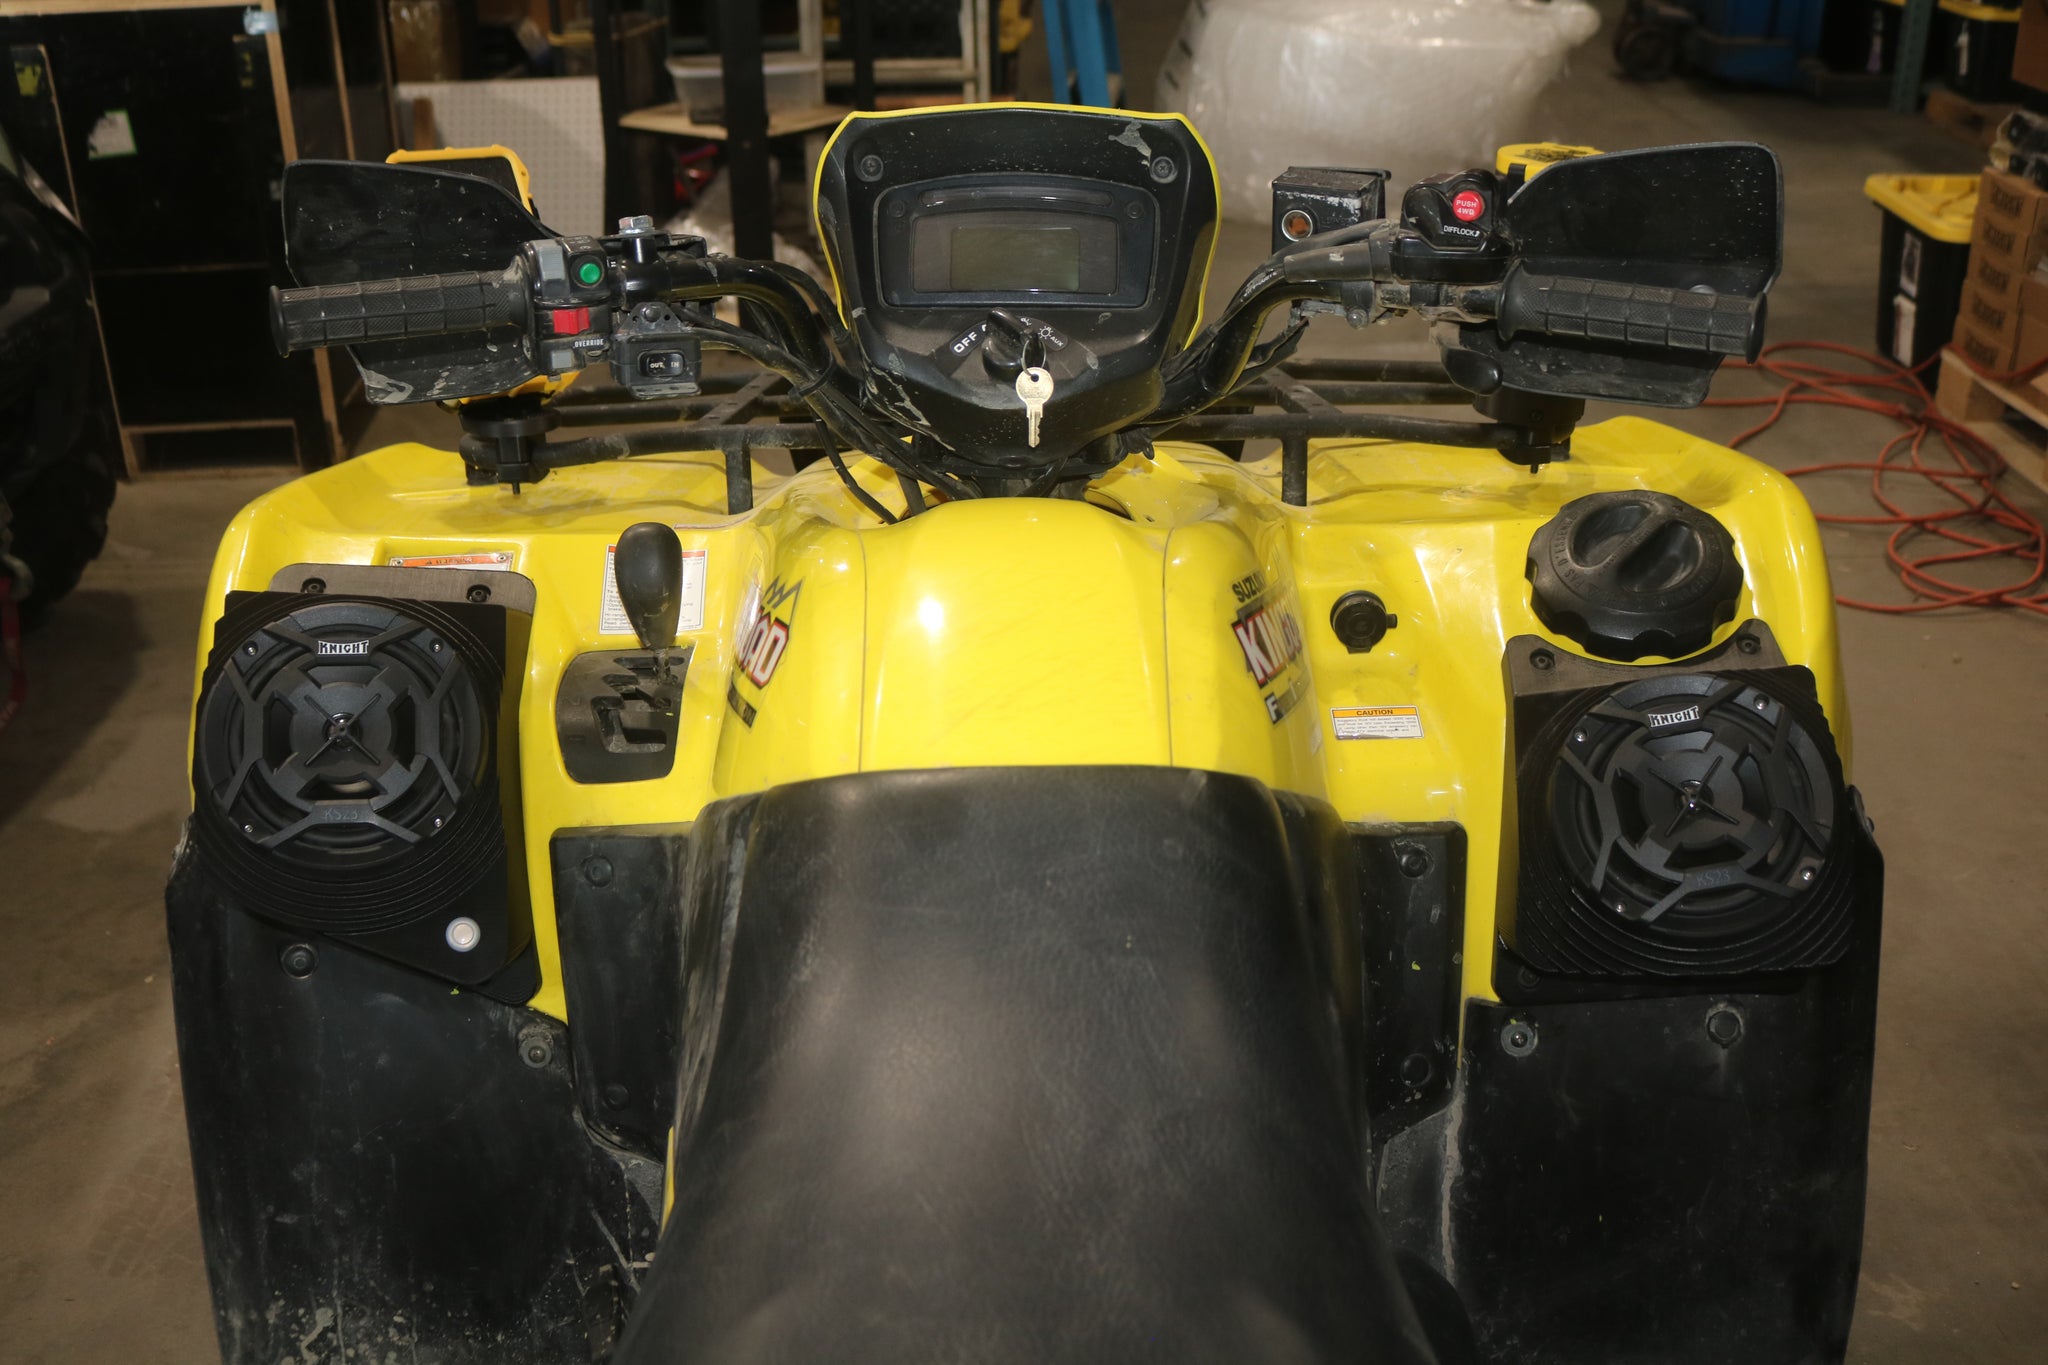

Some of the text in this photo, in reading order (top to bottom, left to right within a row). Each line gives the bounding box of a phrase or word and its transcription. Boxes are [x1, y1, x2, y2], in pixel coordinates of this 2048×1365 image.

[1456, 199, 1477, 208] PUSH
[1443, 225, 1475, 237] DIFFLOCK
[575, 339, 604, 348] OVERRIDE
[953, 332, 979, 353] OFF
[1050, 336, 1064, 347] AUX
[319, 640, 369, 654] KNIGHT
[1356, 709, 1394, 717] CAUTION
[1649, 706, 1699, 727] KNIGHT
